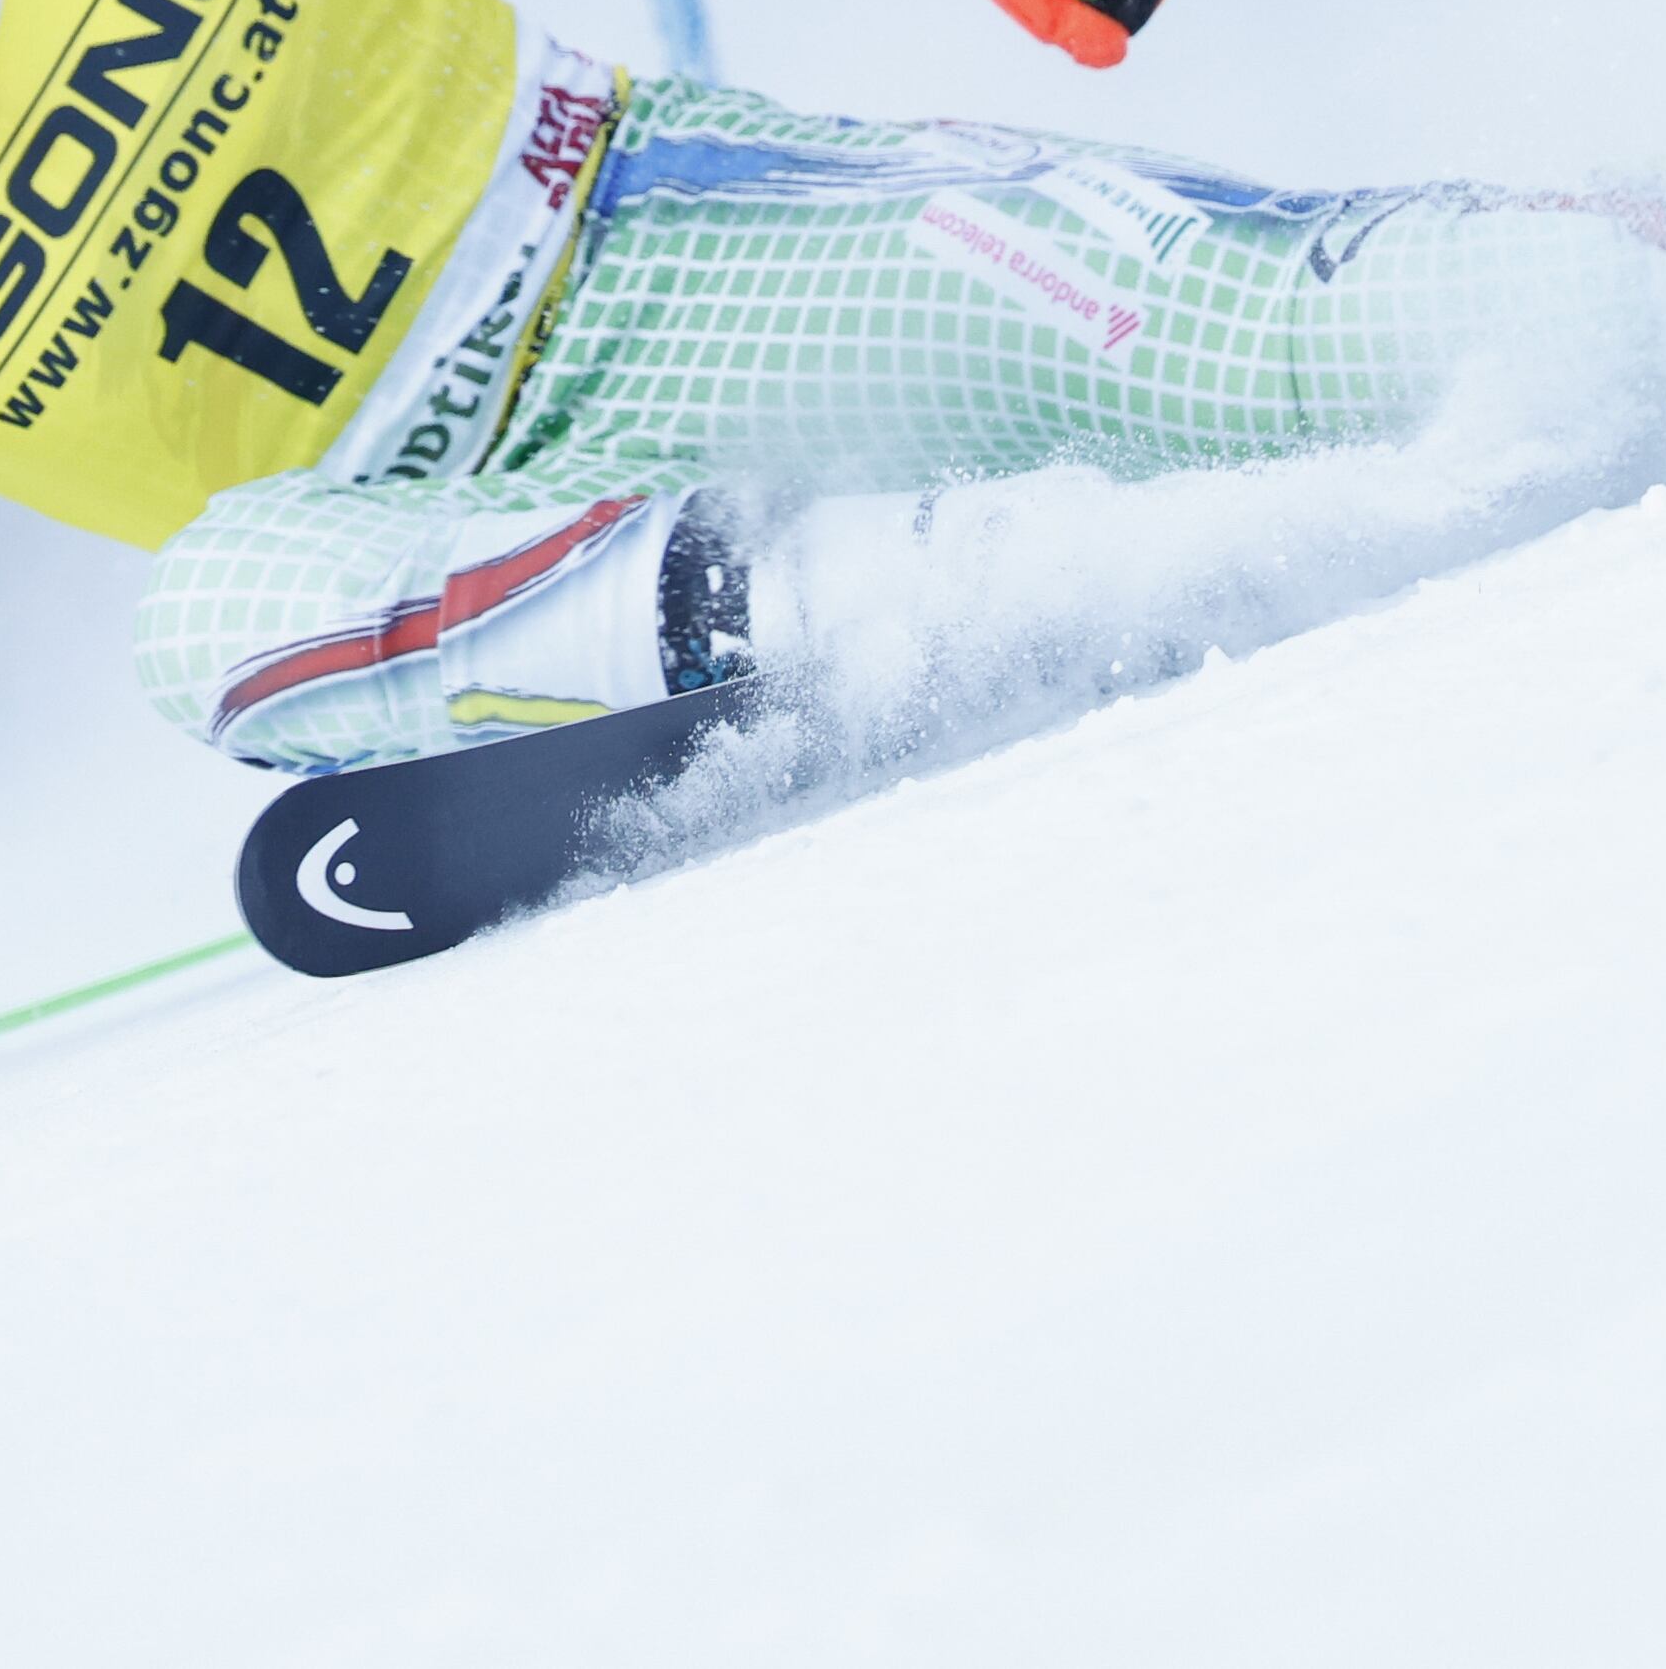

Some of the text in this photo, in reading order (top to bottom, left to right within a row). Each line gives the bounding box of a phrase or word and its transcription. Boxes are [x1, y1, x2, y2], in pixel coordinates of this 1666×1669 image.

[157, 167, 414, 409] 12
[921, 203, 1101, 321] andorra telecom
